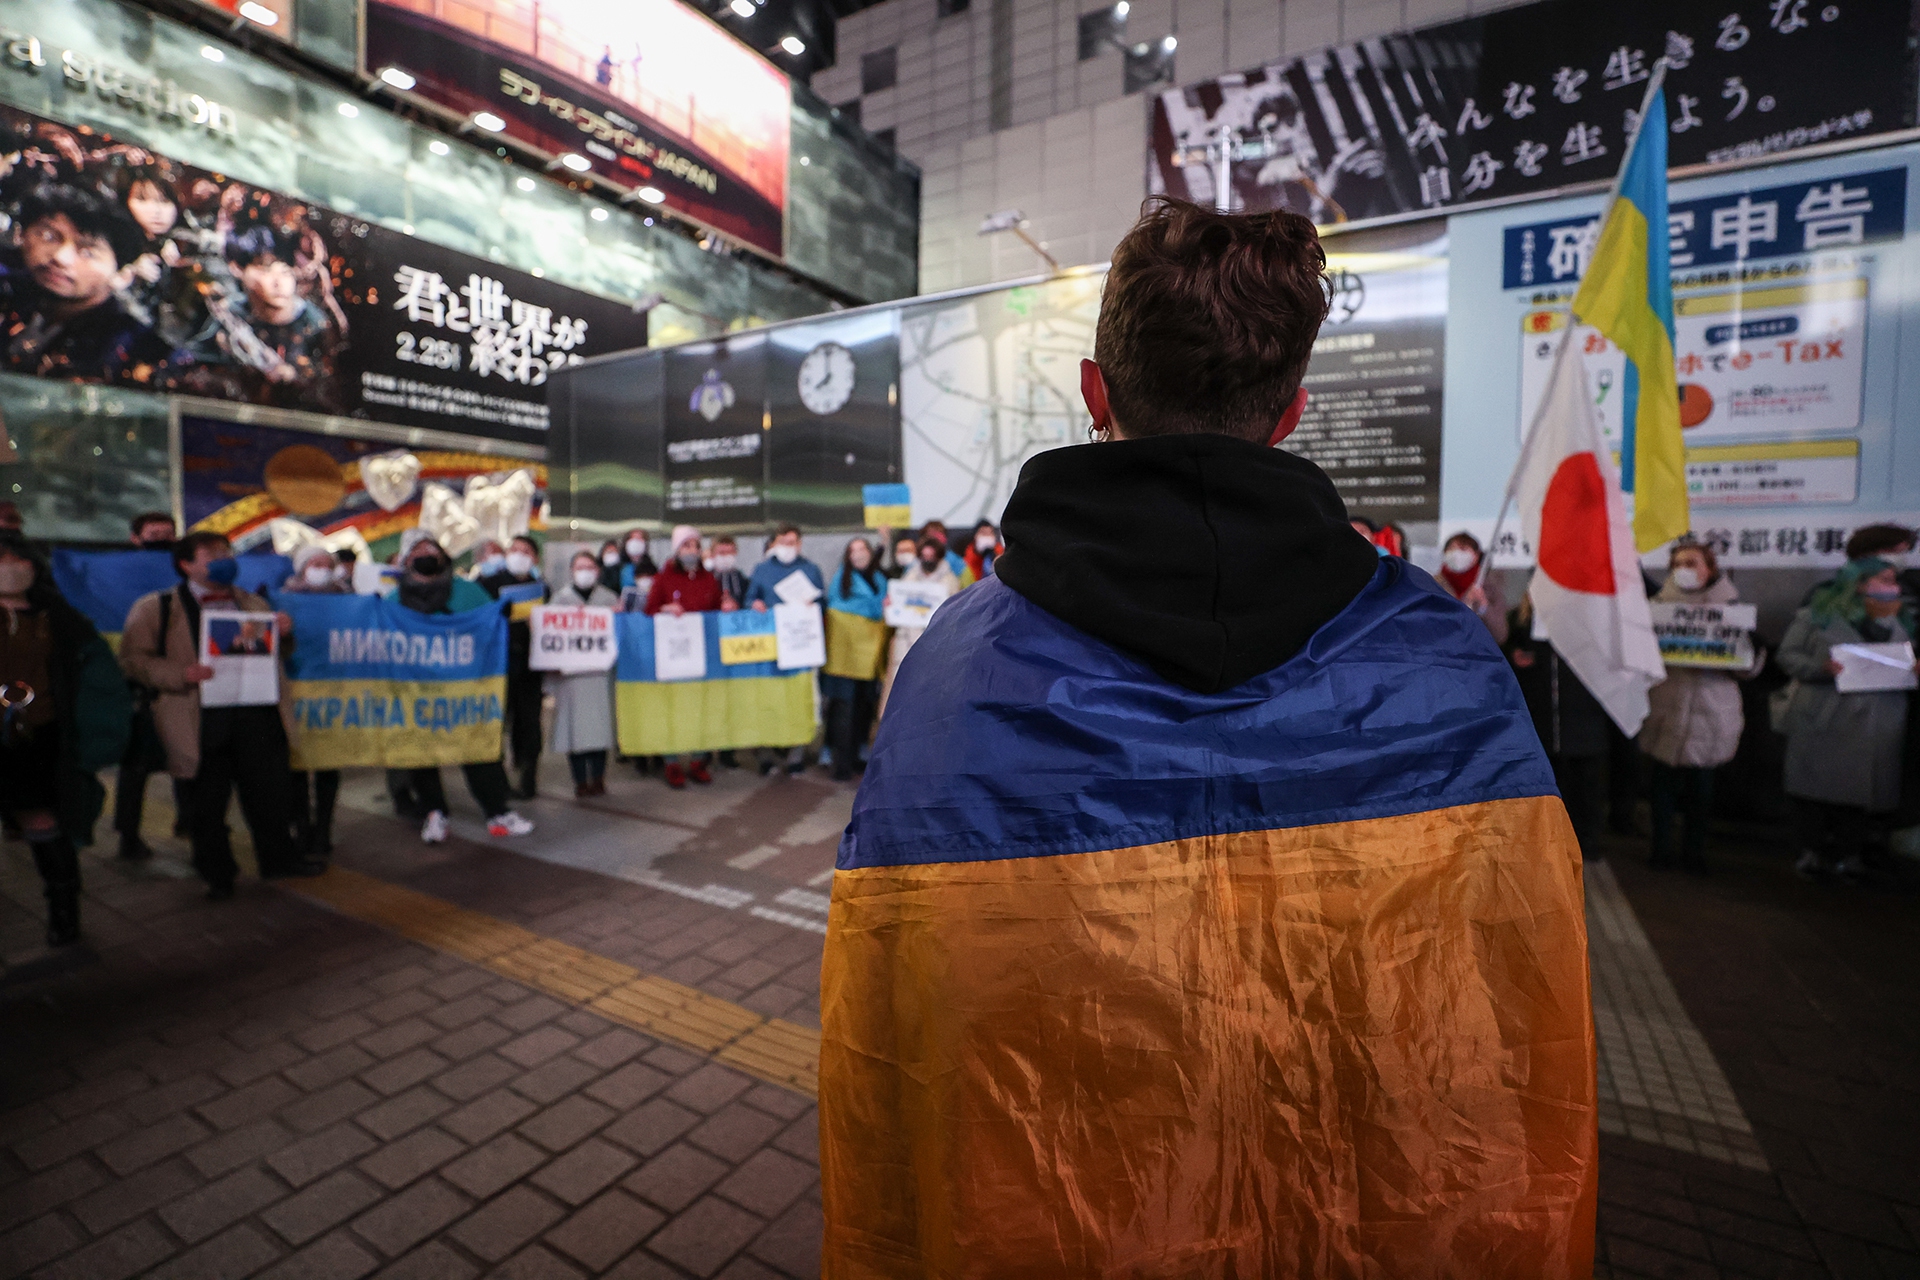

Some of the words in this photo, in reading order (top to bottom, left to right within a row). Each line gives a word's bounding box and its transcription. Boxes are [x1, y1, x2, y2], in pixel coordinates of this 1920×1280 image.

[653, 147, 718, 196] JAPAN
[393, 264, 590, 355] 君と世界が
[469, 322, 586, 387] 終わ
[1731, 339, 1845, 371] e-Tax
[328, 629, 476, 666] МИКОЛАЇВ
[540, 634, 564, 653] GO
[567, 634, 608, 653] HOME
[413, 694, 504, 734] ЄДИНА
